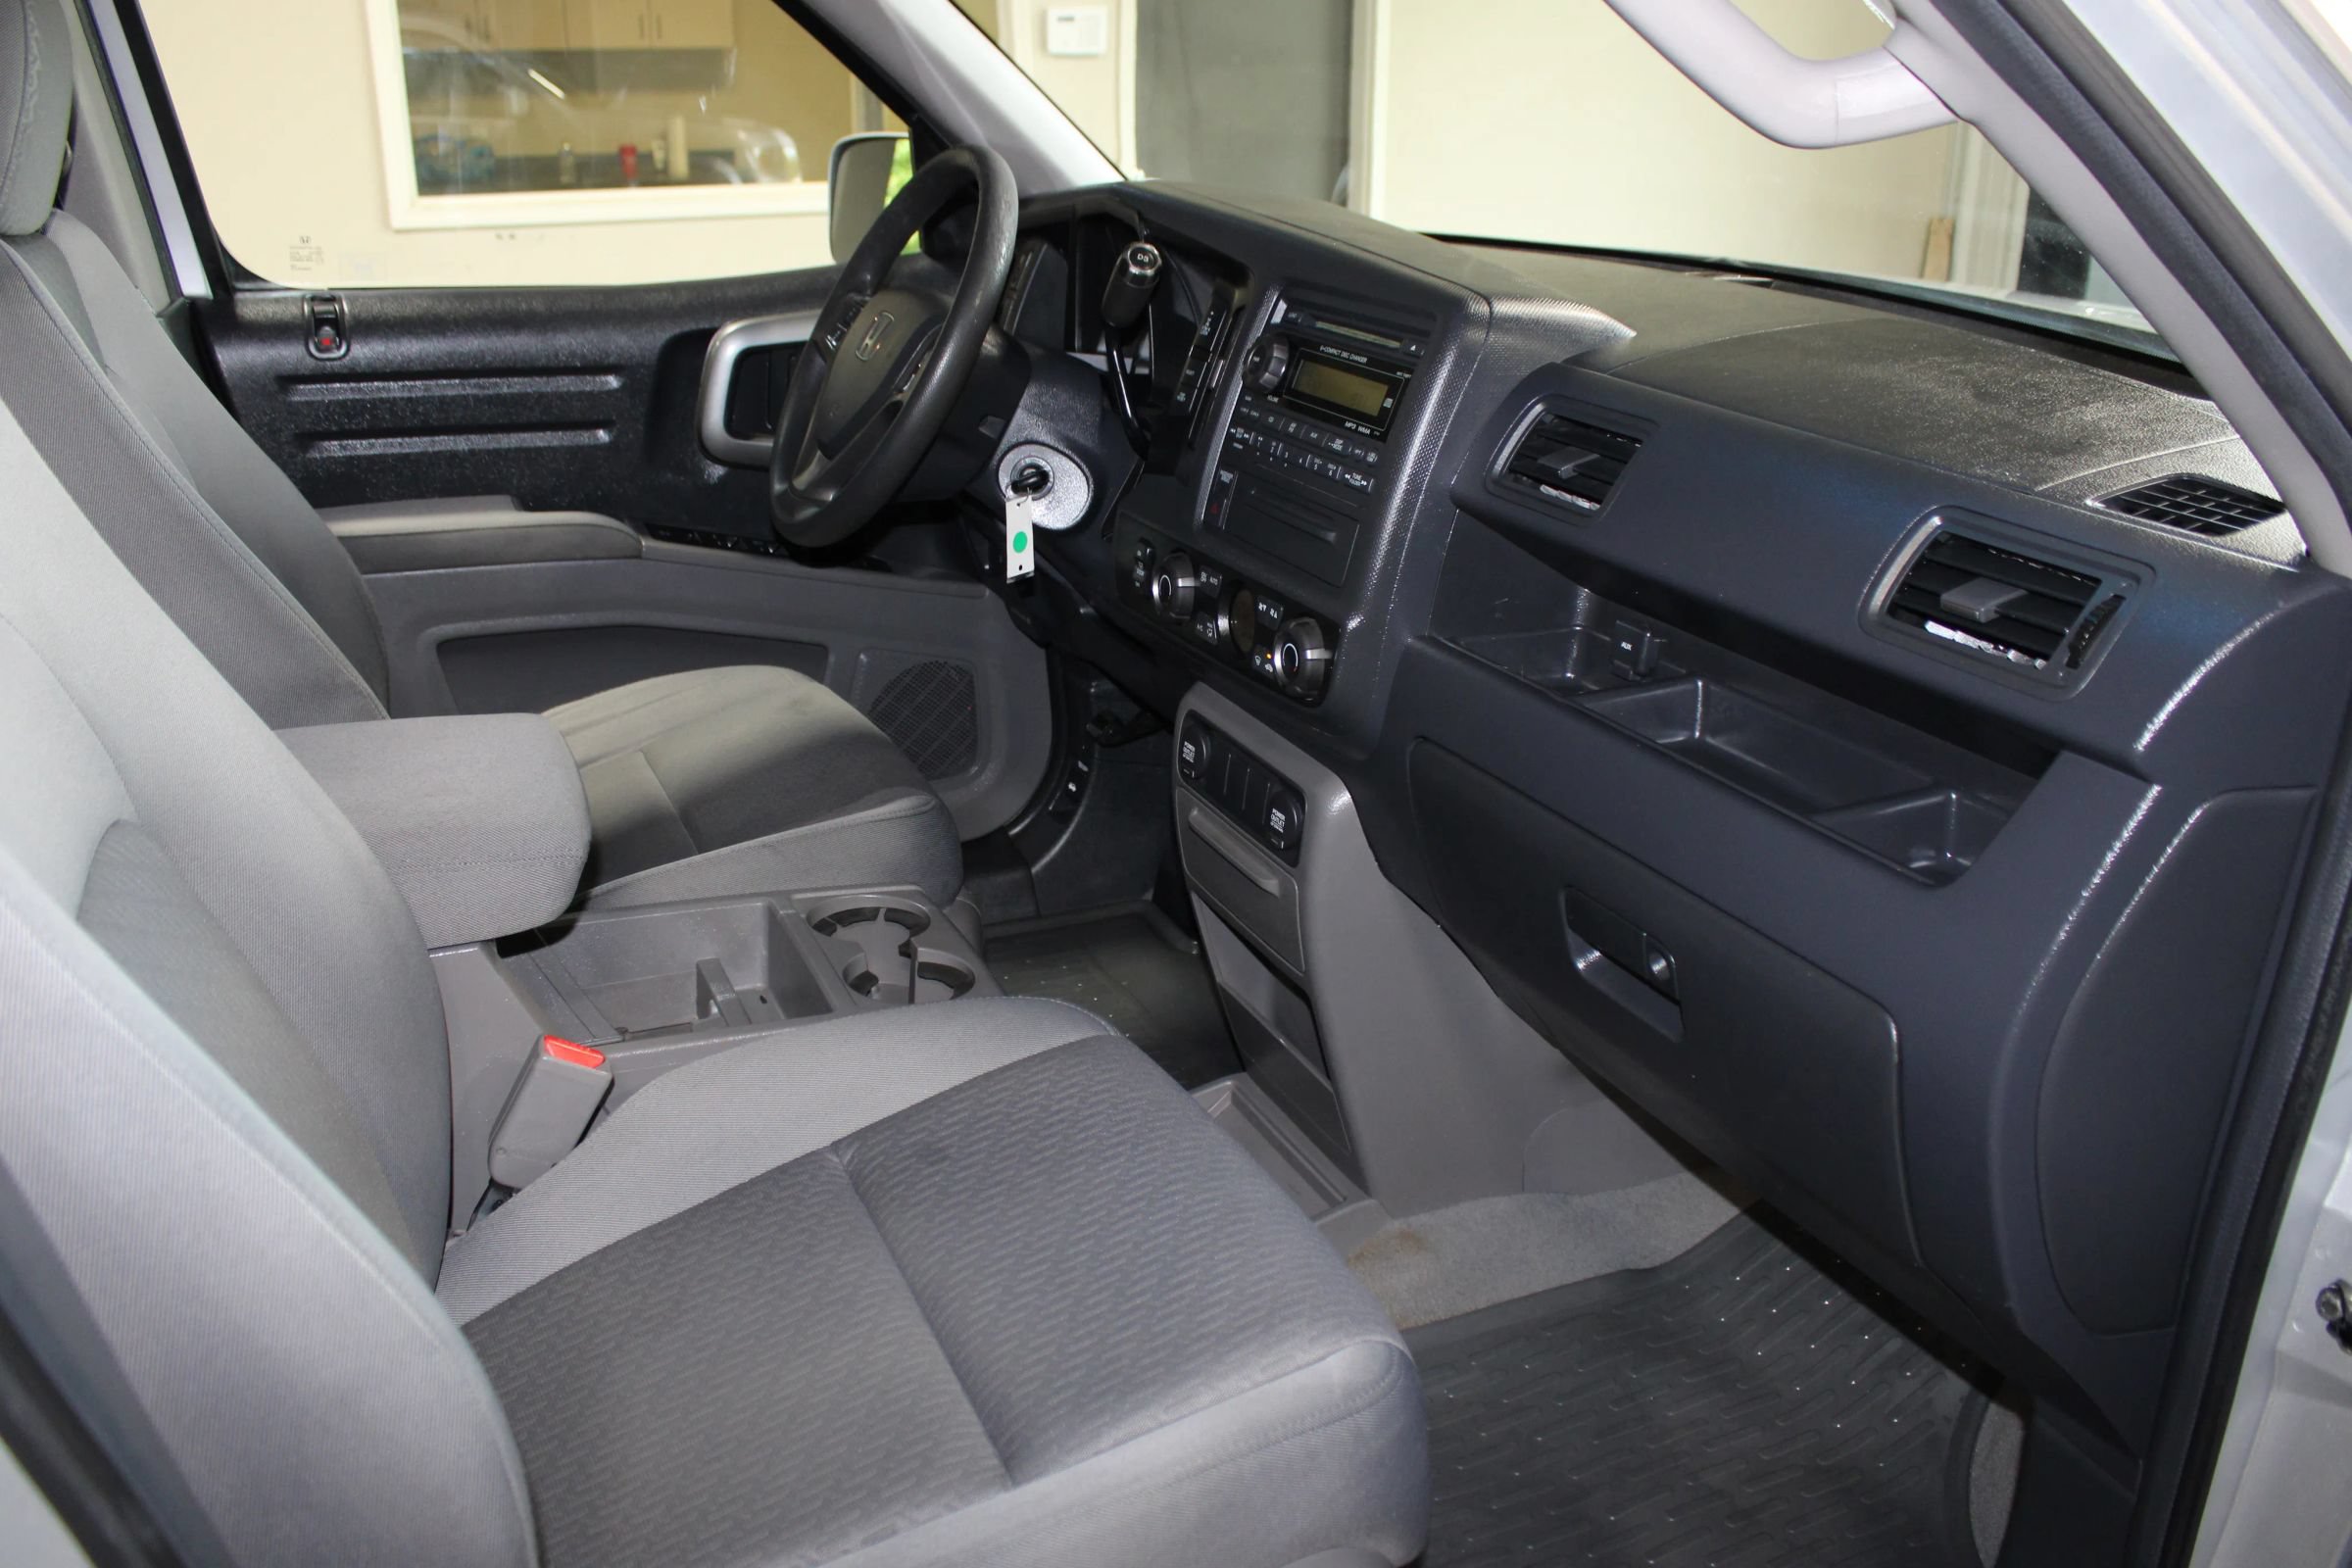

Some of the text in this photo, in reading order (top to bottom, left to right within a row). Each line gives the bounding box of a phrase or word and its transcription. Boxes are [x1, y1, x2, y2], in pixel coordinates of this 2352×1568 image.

[1345, 420, 1356, 430] MP3
[1357, 425, 1371, 435] WMA
[1621, 641, 1633, 651] AUX
[1270, 813, 1285, 827] OUTLET
[1272, 808, 1286, 821] POWER
